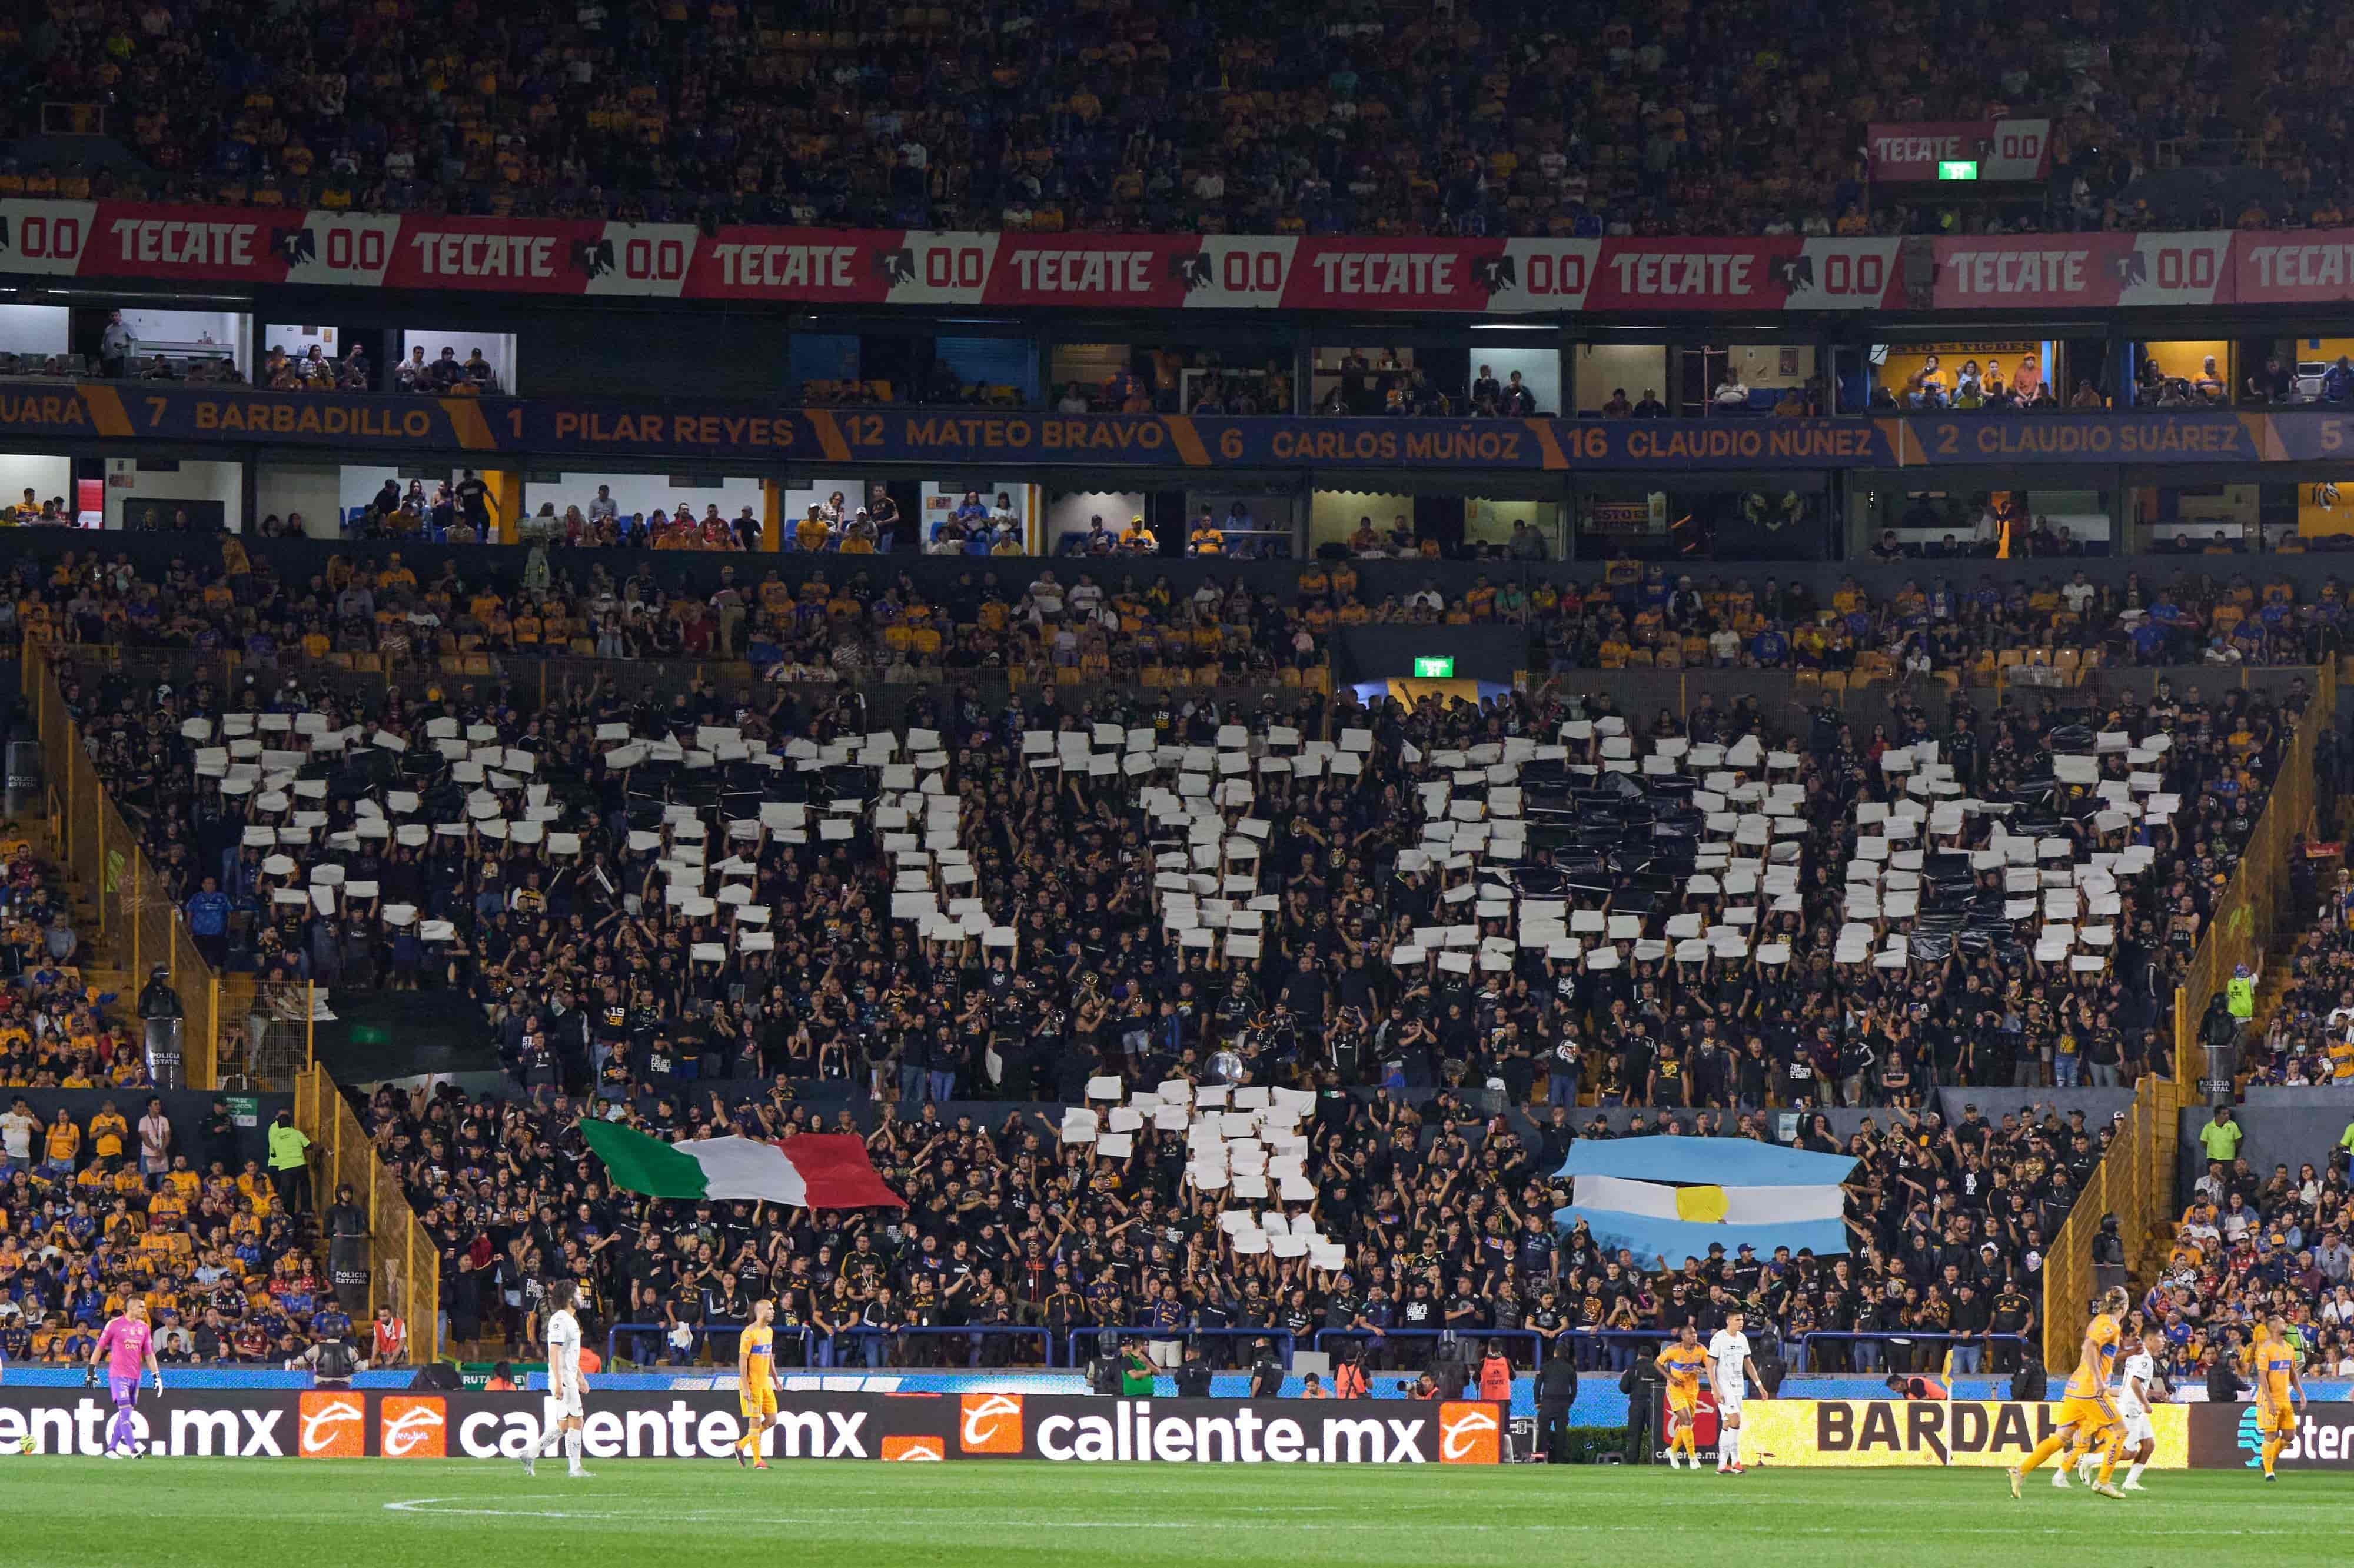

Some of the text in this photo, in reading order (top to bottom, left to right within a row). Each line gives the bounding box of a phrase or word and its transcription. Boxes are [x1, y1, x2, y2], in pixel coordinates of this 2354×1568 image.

[1875, 136, 1961, 162] TECATE
[111, 219, 257, 265] TECATE
[411, 232, 556, 277] TECATE
[713, 244, 857, 286] TECATE
[1010, 250, 1154, 291] TECATE
[1314, 253, 1458, 294] TECATE
[1610, 254, 1755, 294] TECATE
[1948, 251, 2089, 292] TECATE
[146, 397, 430, 437] 7 BARBADILLO
[508, 408, 793, 445] 1 PILAR REYES
[845, 415, 1163, 448] 12 MATEO BRAVO
[1938, 418, 2239, 452] 2 CLAUDIO SUÁREZ
[2320, 420, 2342, 450] 5
[1221, 424, 1519, 460] 6 CARLOS MUÑOZ
[1567, 422, 1871, 458] 16 CLAUDIO NÚÑEZ
[463, 1375, 493, 1384] RUTA
[458, 1396, 867, 1457] calente.mx
[1038, 1401, 1425, 1463] caliente.mx
